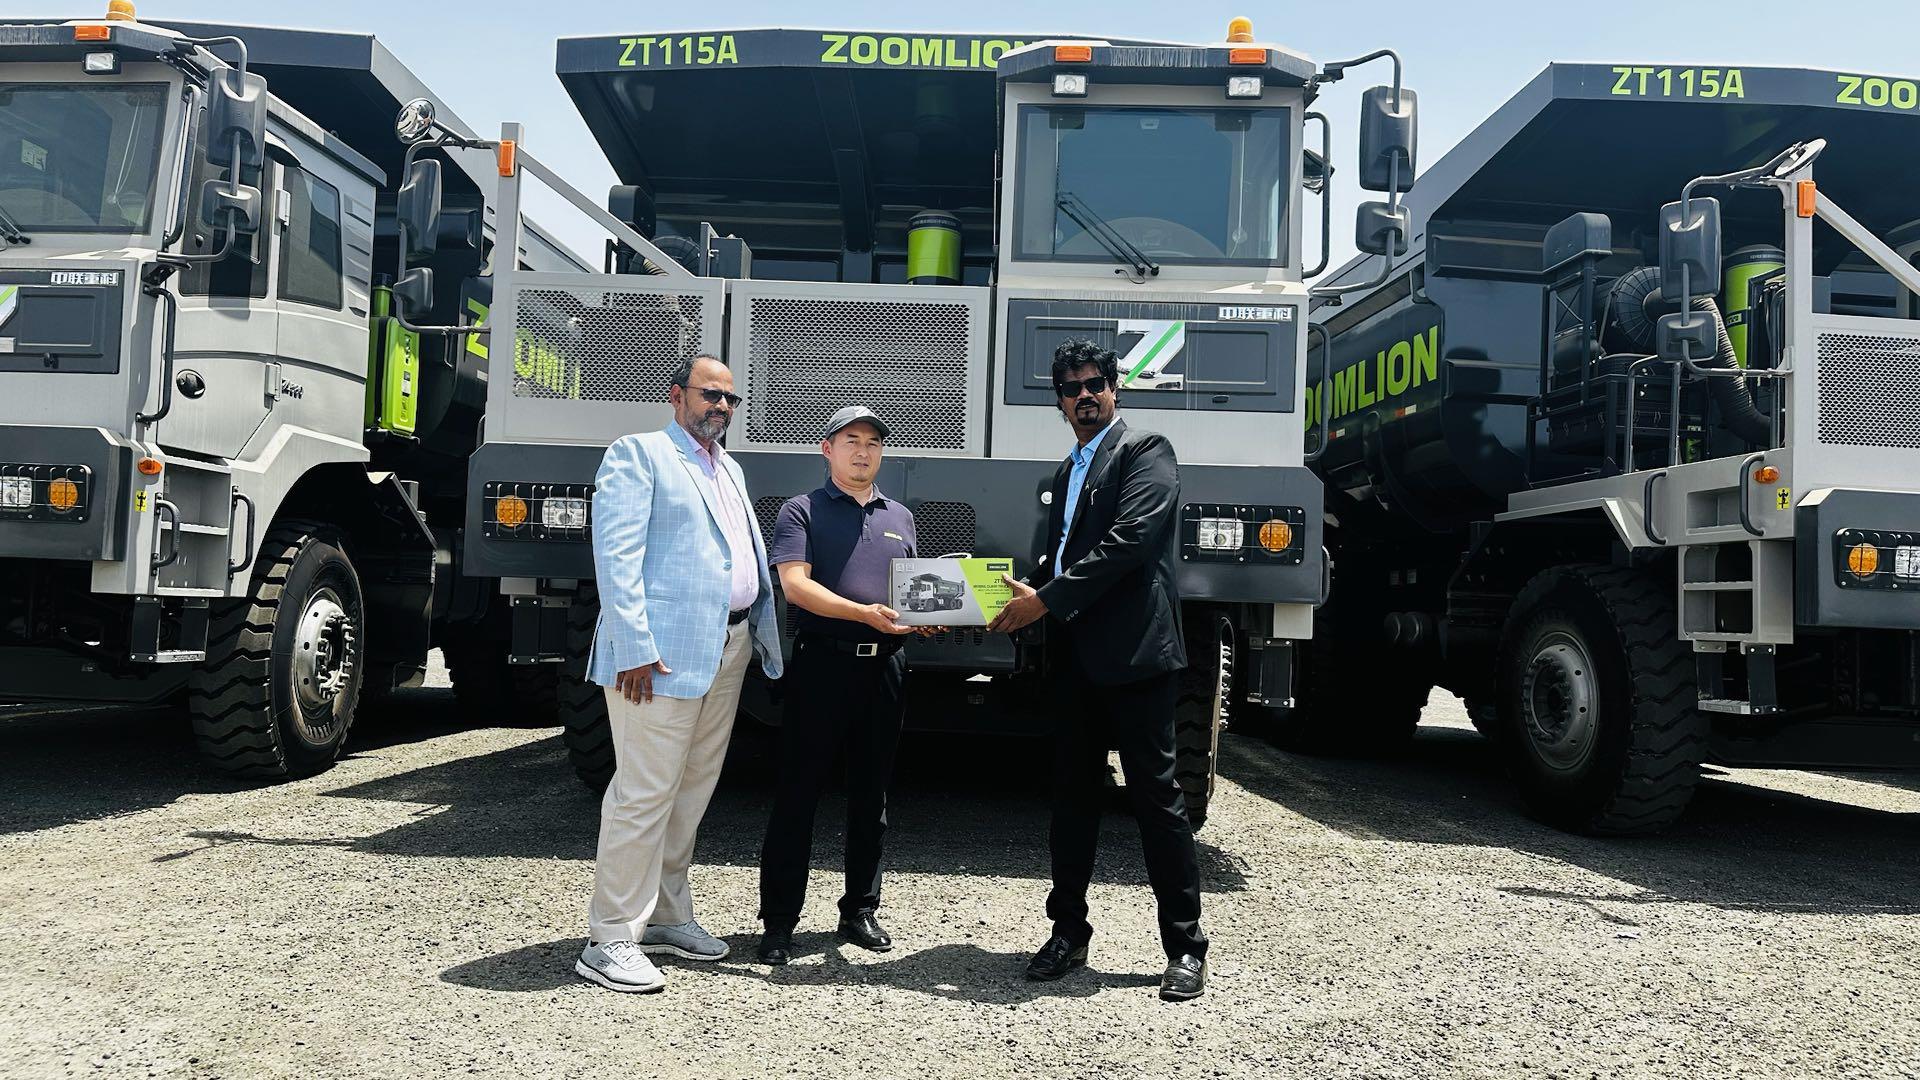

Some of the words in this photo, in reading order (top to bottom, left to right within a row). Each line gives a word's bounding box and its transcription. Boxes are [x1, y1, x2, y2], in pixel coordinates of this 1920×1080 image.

[618, 35, 739, 66] ZT115A
[821, 34, 1031, 68] ZOOMLIO
[1611, 67, 1744, 98] ZT115A
[1836, 75, 1920, 109] ZOO
